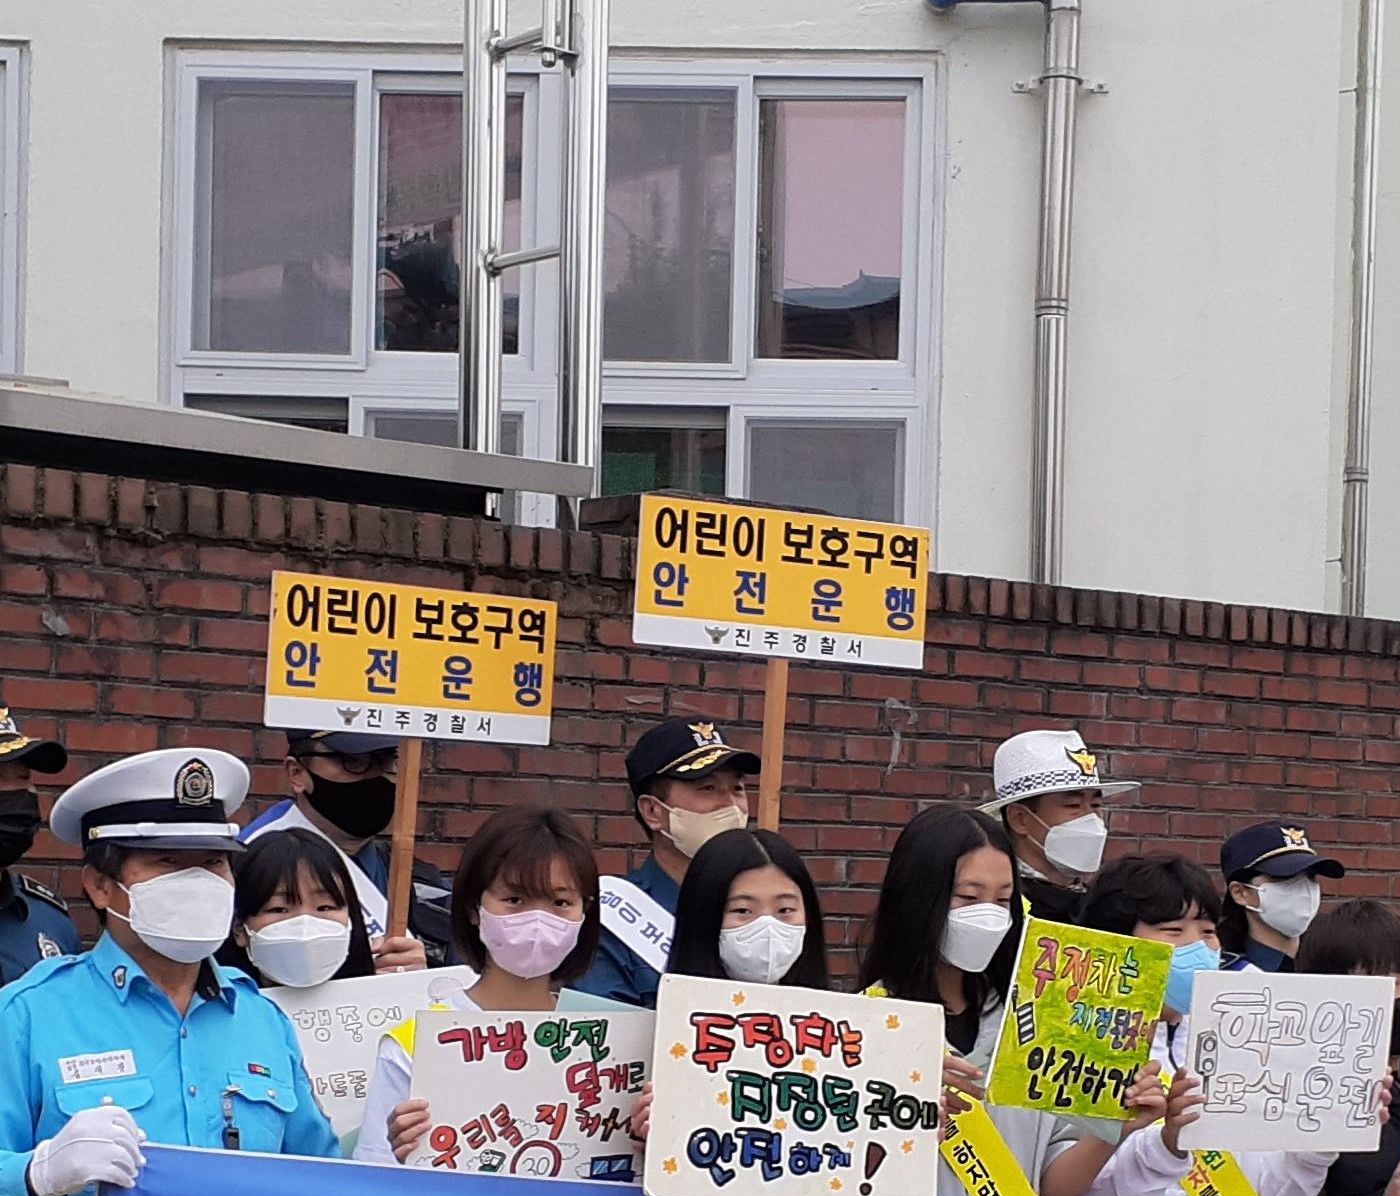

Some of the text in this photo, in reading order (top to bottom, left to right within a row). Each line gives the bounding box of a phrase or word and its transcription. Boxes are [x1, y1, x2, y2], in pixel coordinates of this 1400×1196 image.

[655, 505, 919, 580] 어린이 보호구역
[286, 582, 547, 655] 어린이 보호구역
[1032, 937, 1140, 1003] 주정차는
[438, 1018, 611, 1070] 가방 안전
[690, 1012, 862, 1073] 주정차는
